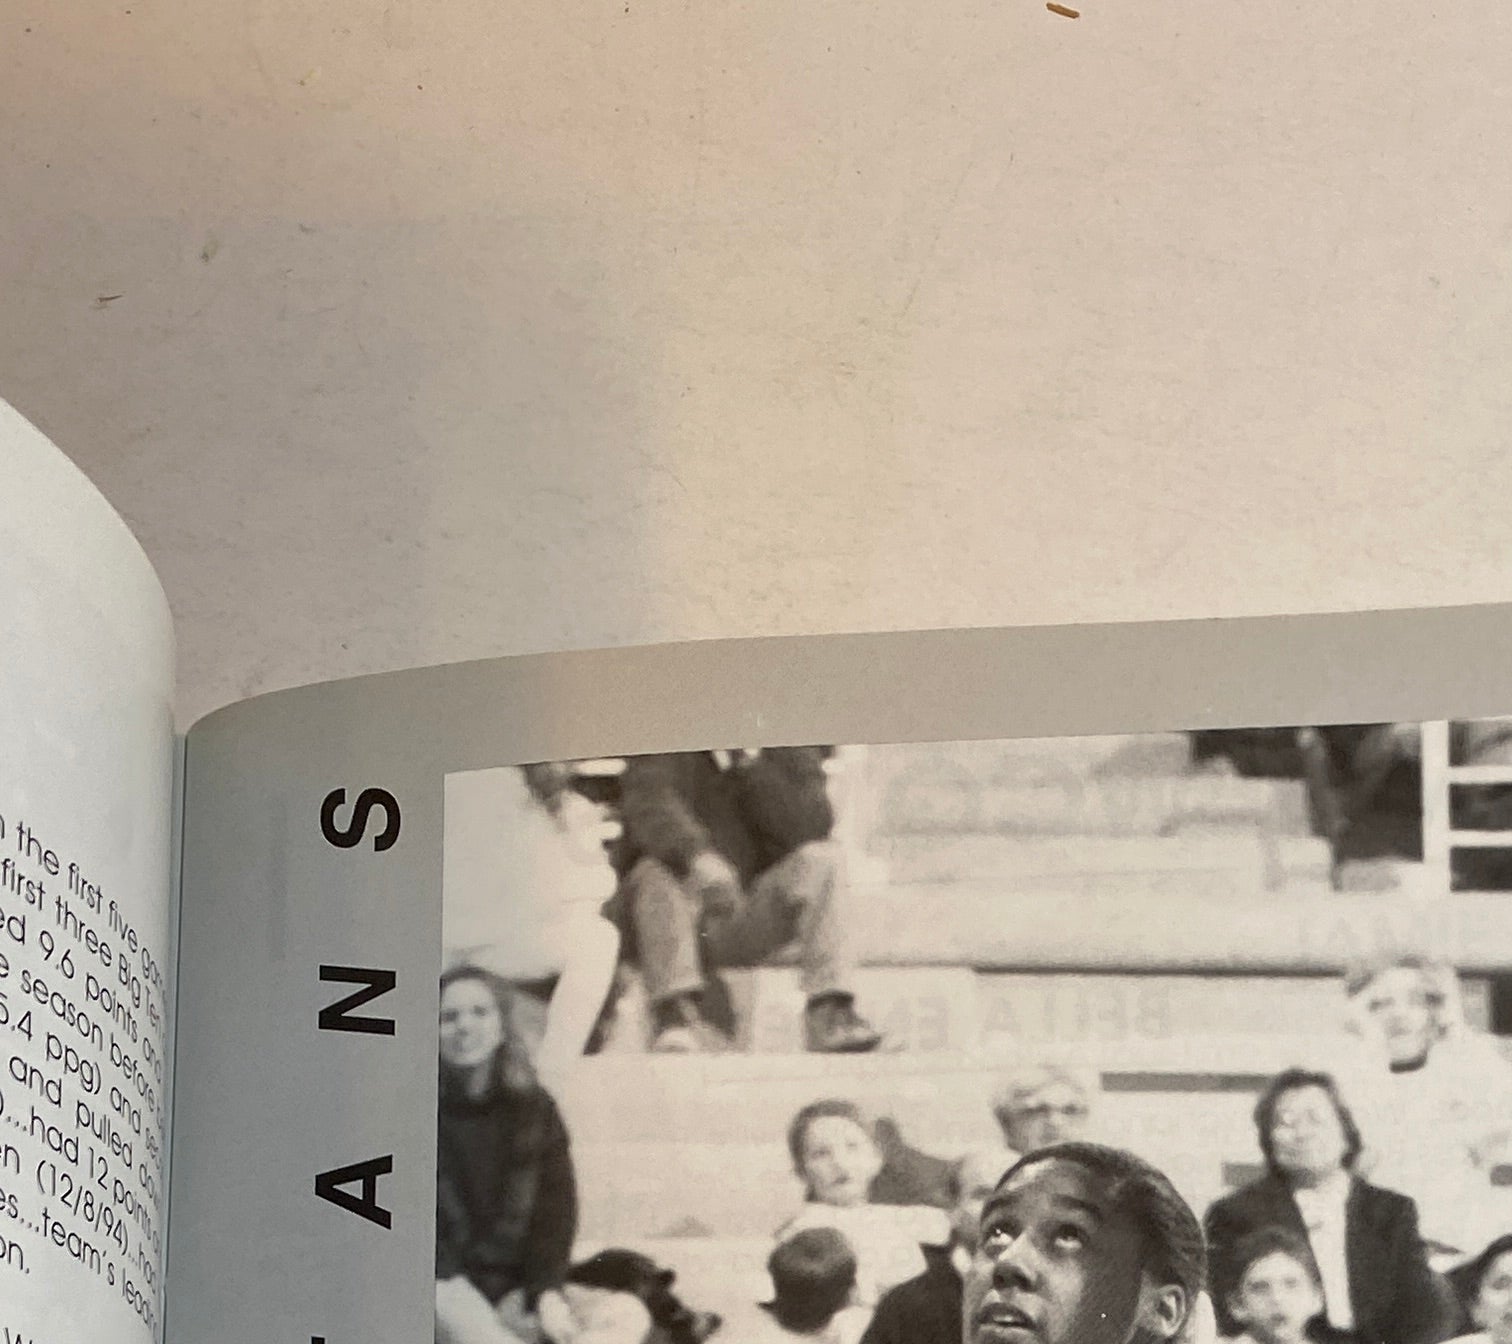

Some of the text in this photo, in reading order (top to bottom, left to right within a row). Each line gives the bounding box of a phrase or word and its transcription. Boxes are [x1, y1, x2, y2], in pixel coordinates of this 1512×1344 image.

[1, 857, 46, 912] first
[55, 895, 113, 968] three
[118, 952, 141, 1009] Big
[17, 821, 60, 876] the
[68, 862, 103, 915] first
[108, 900, 139, 954] five
[20, 968, 104, 1052] season
[39, 929, 75, 980] 9.6
[86, 971, 139, 1044] points
[9, 1056, 63, 1109] and
[75, 1099, 133, 1170] pulled
[46, 1031, 102, 1096] ppg)
[109, 1086, 142, 1137] and
[88, 1146, 109, 1191] 12
[113, 1176, 152, 1241] points
